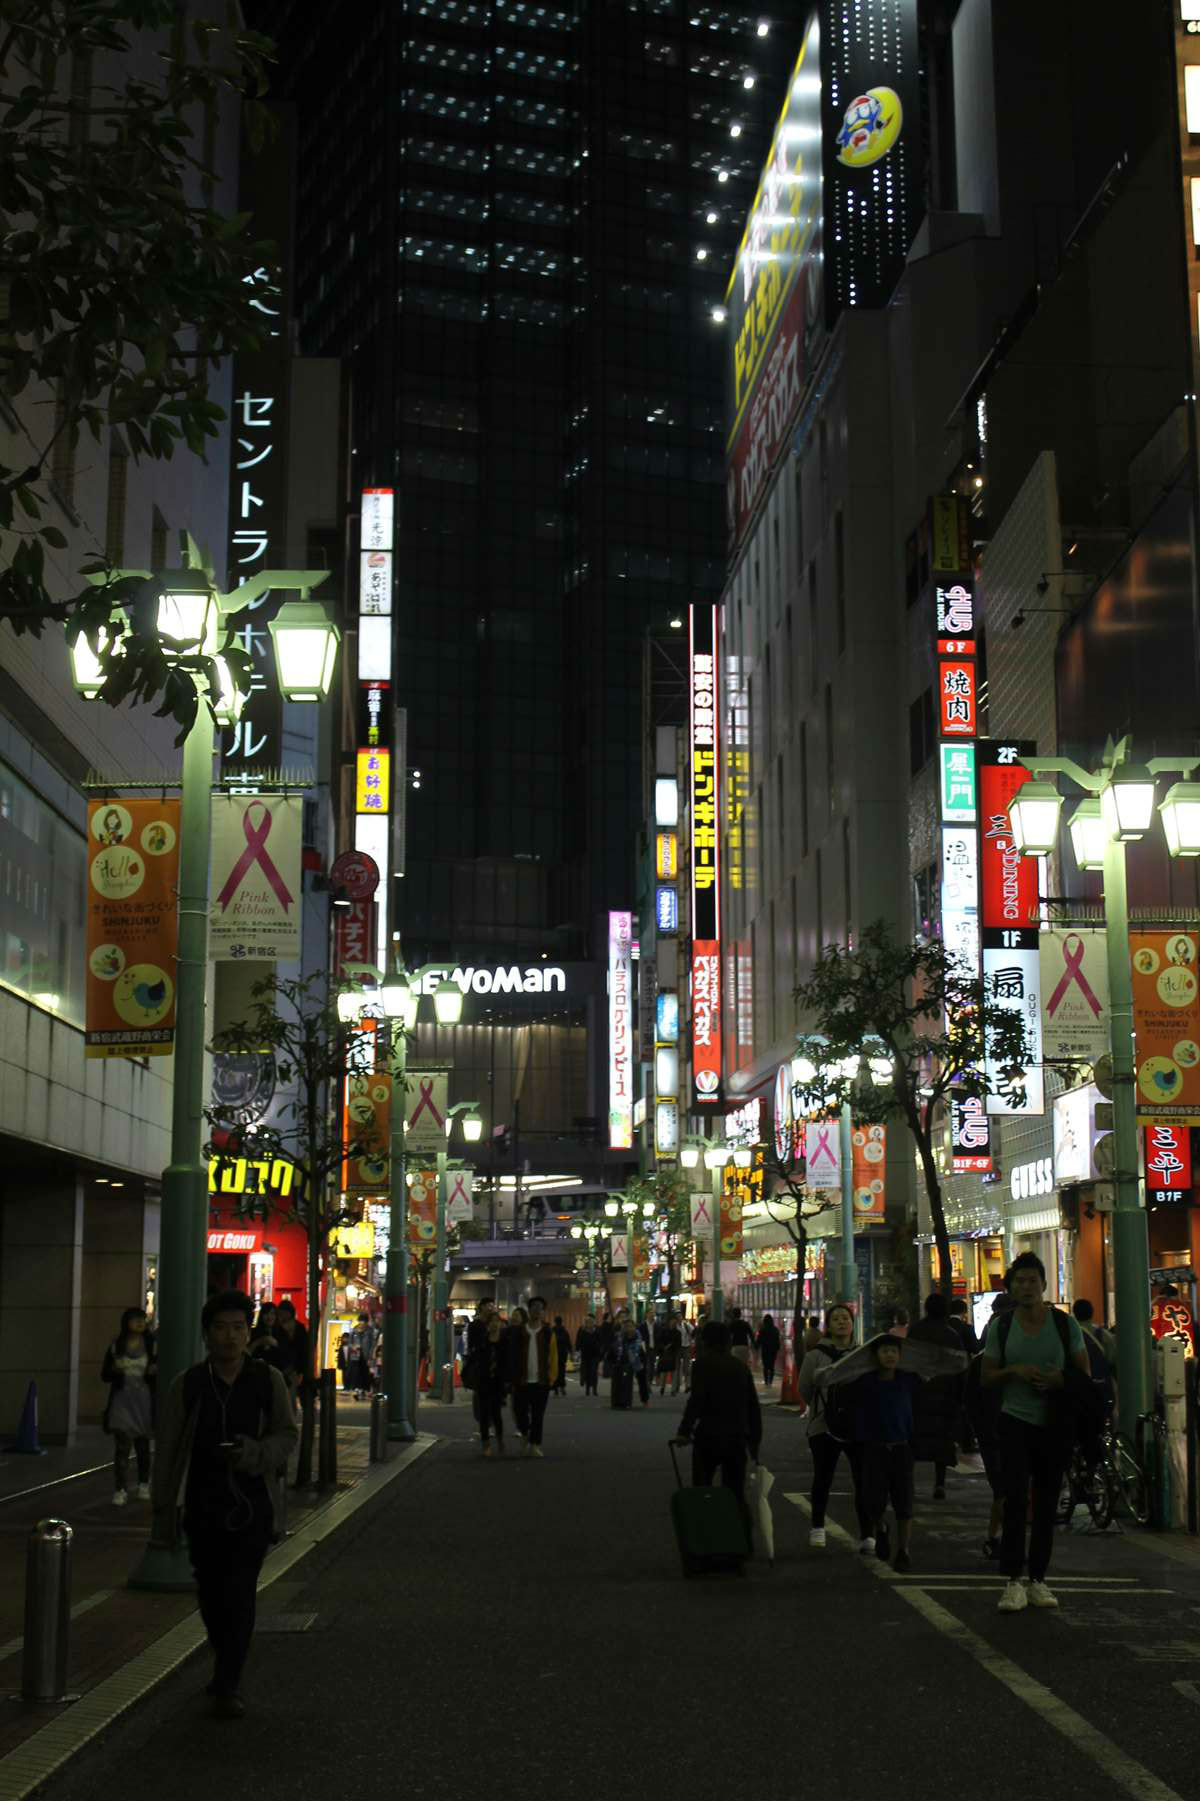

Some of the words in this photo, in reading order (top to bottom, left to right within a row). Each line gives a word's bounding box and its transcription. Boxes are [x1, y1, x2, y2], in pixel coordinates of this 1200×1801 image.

[997, 747, 1018, 763] 2F
[240, 891, 269, 902] Pink
[233, 903, 276, 915] Ribbon
[101, 914, 161, 927] SHINJUKU
[344, 892, 364, 962] パチス
[1003, 930, 1021, 948] 1F
[247, 946, 277, 957] 新宿区
[694, 956, 712, 1046] ベガスベガス
[1062, 1001, 1085, 1011] Pink
[1143, 1020, 1190, 1028] SHINJUKU
[1147, 1125, 1185, 1185] 三平
[1010, 1156, 1054, 1201] GUESS
[1155, 1191, 1183, 1202] B1F
[223, 1233, 257, 1250] GOKU
